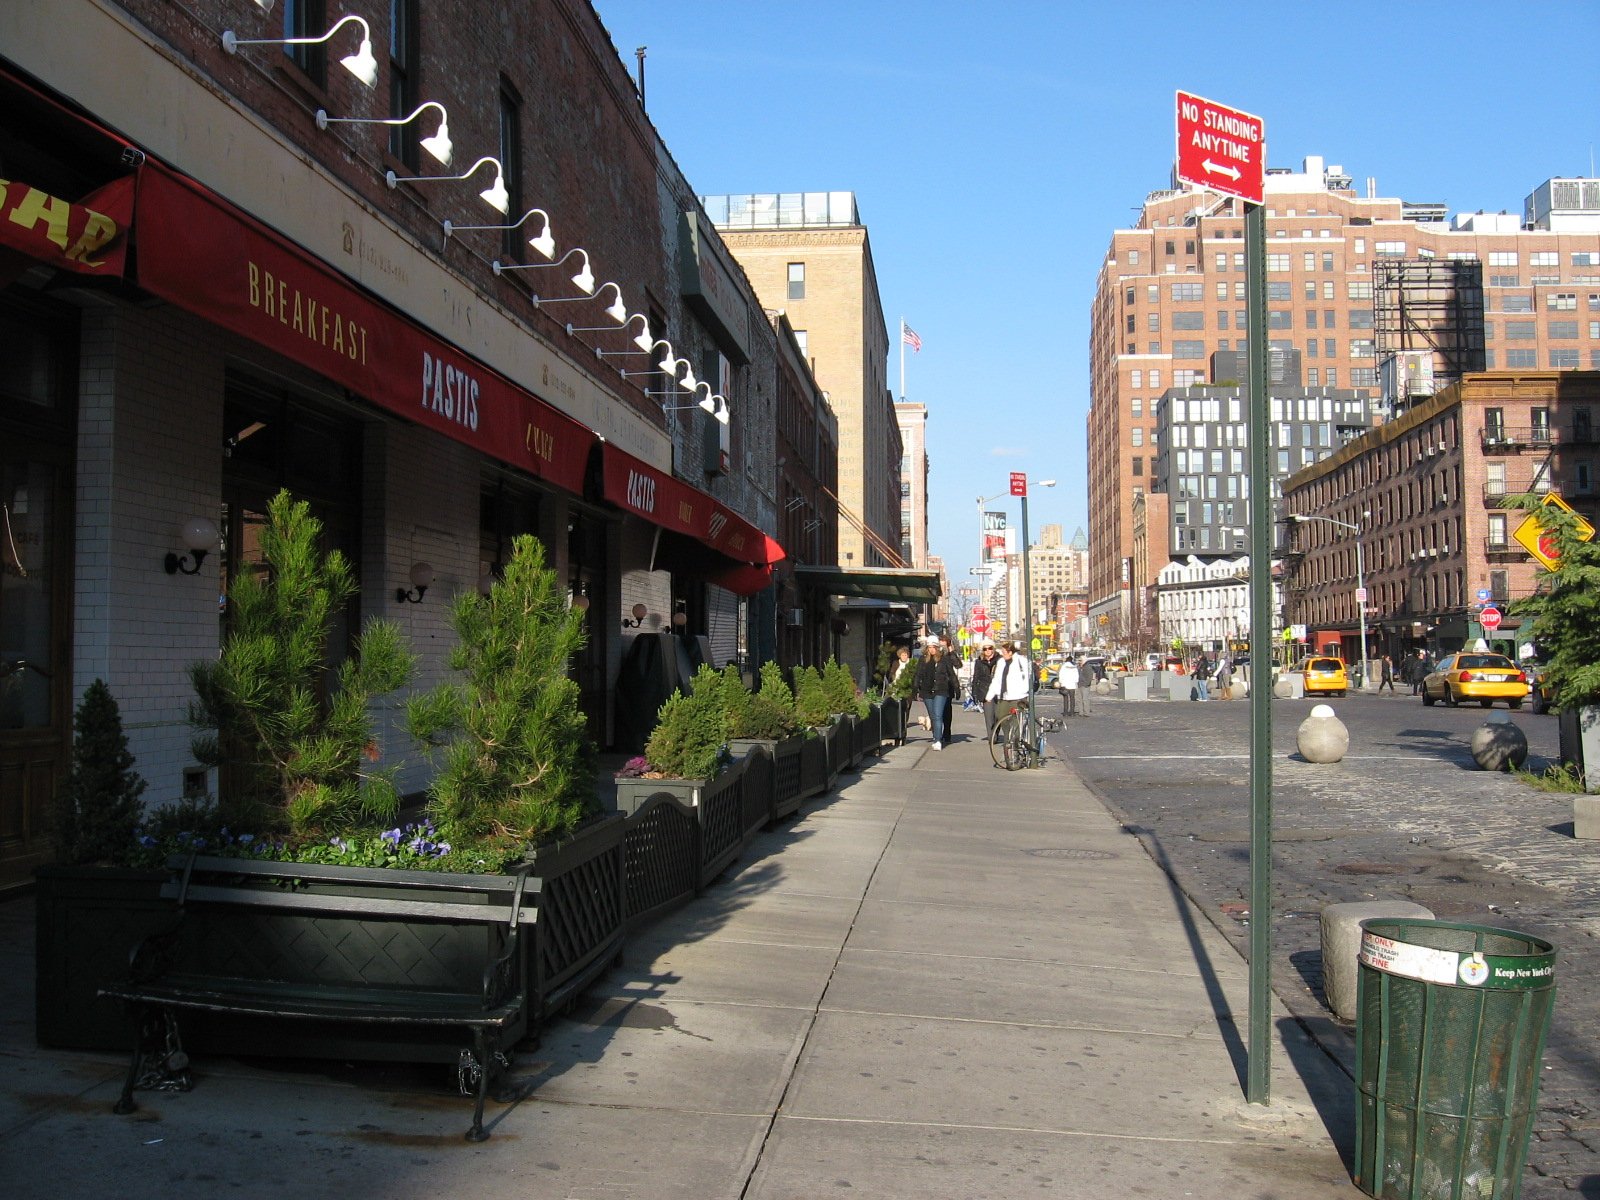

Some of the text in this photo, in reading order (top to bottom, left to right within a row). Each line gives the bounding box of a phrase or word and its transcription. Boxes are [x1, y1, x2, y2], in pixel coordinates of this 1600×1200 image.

[1182, 101, 1258, 143] NO STANDING
[1191, 130, 1251, 164] ANYTIME
[249, 260, 368, 366] BREAKFAST
[421, 351, 479, 433] PASTIS
[627, 469, 656, 513] PASTIS
[984, 514, 1006, 530] NYC
[972, 619, 990, 628] STOP
[1481, 613, 1500, 622] STOP
[1374, 936, 1395, 948] ONLY
[1377, 952, 1396, 962] TRASH
[1381, 947, 1400, 957] TRASH
[1371, 957, 1389, 969] FINE
[1495, 967, 1515, 980] Keep
[1516, 968, 1531, 978] New
[1531, 967, 1544, 977] York
